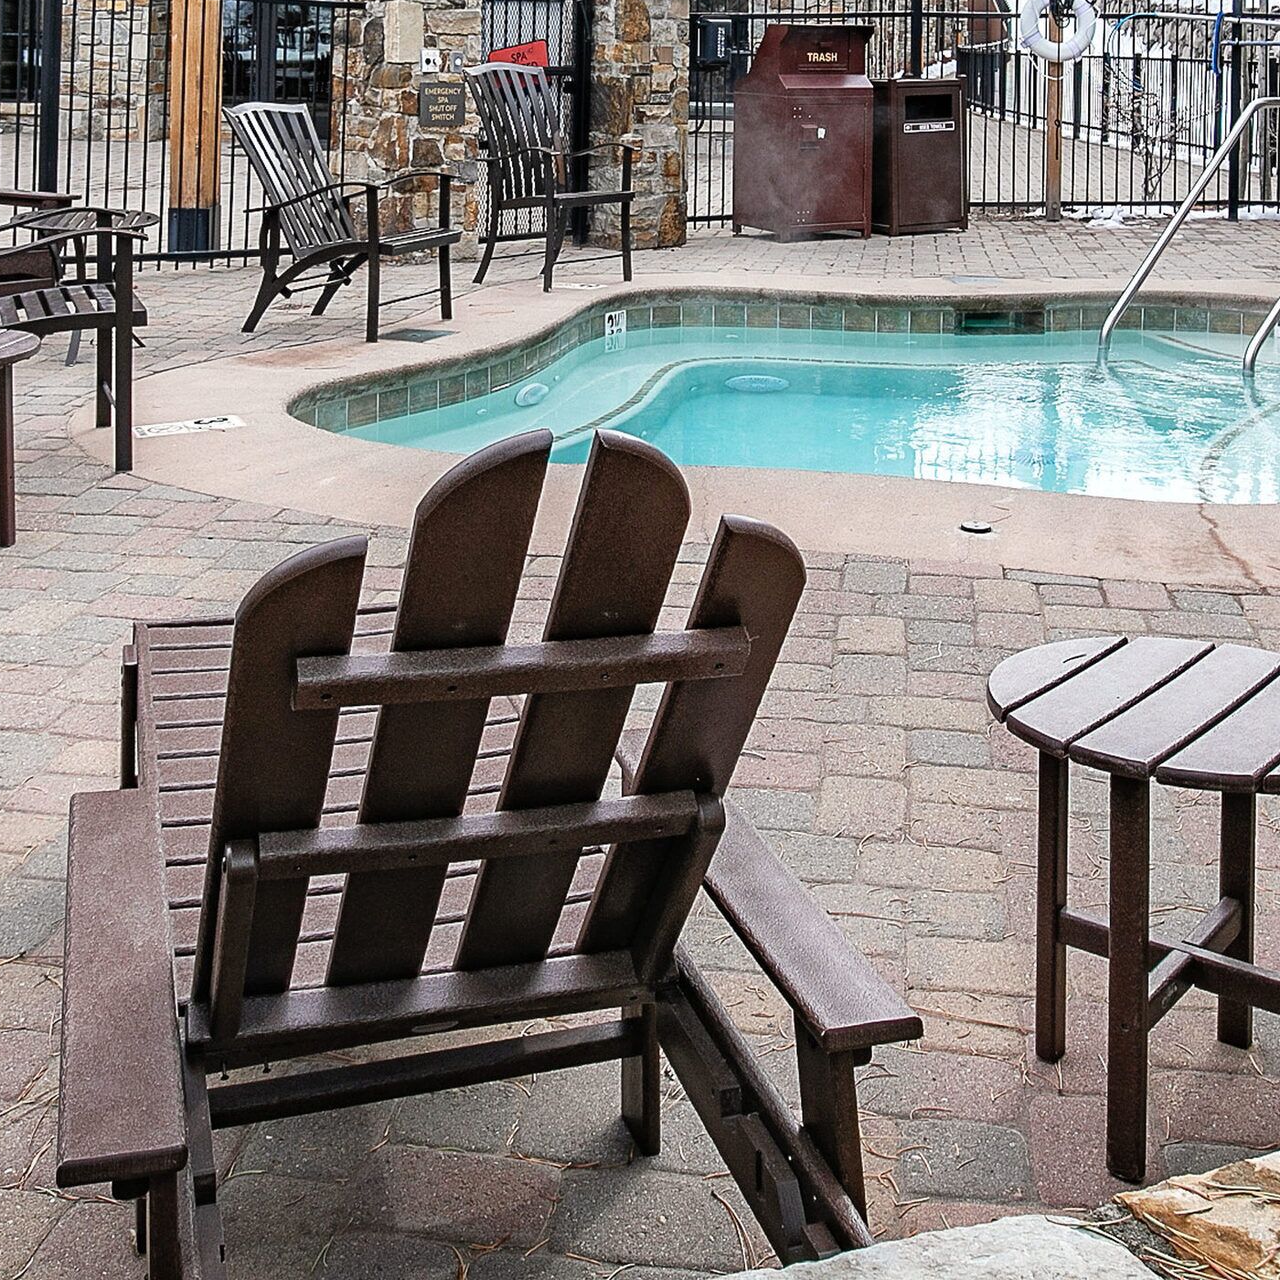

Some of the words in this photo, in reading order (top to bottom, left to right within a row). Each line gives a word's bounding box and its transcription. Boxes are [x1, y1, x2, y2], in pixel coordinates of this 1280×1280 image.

[510, 52, 528, 64] SPA
[806, 52, 838, 62] TRASH
[424, 87, 461, 95] EMERGENCY
[431, 113, 455, 121] SWITCH
